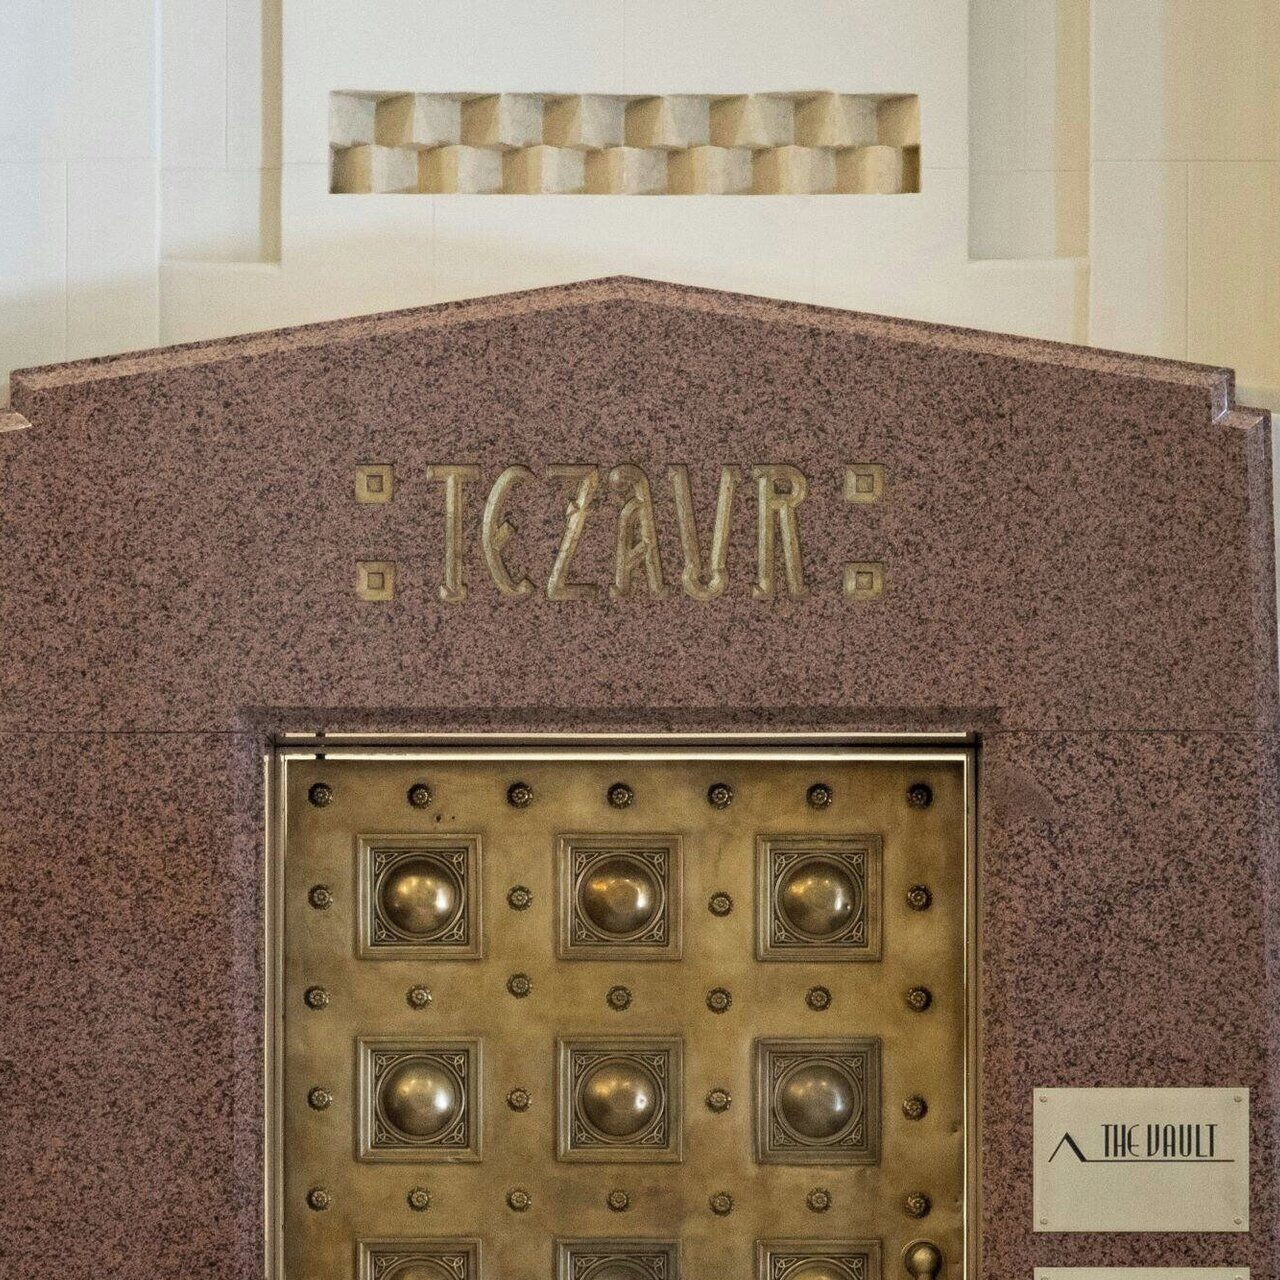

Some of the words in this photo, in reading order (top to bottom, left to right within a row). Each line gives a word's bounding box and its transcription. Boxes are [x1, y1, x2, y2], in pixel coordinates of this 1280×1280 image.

[425, 463, 810, 600] TEZAUR
[1100, 1123, 1140, 1158] THE
[1146, 1123, 1218, 1158] VAULT
